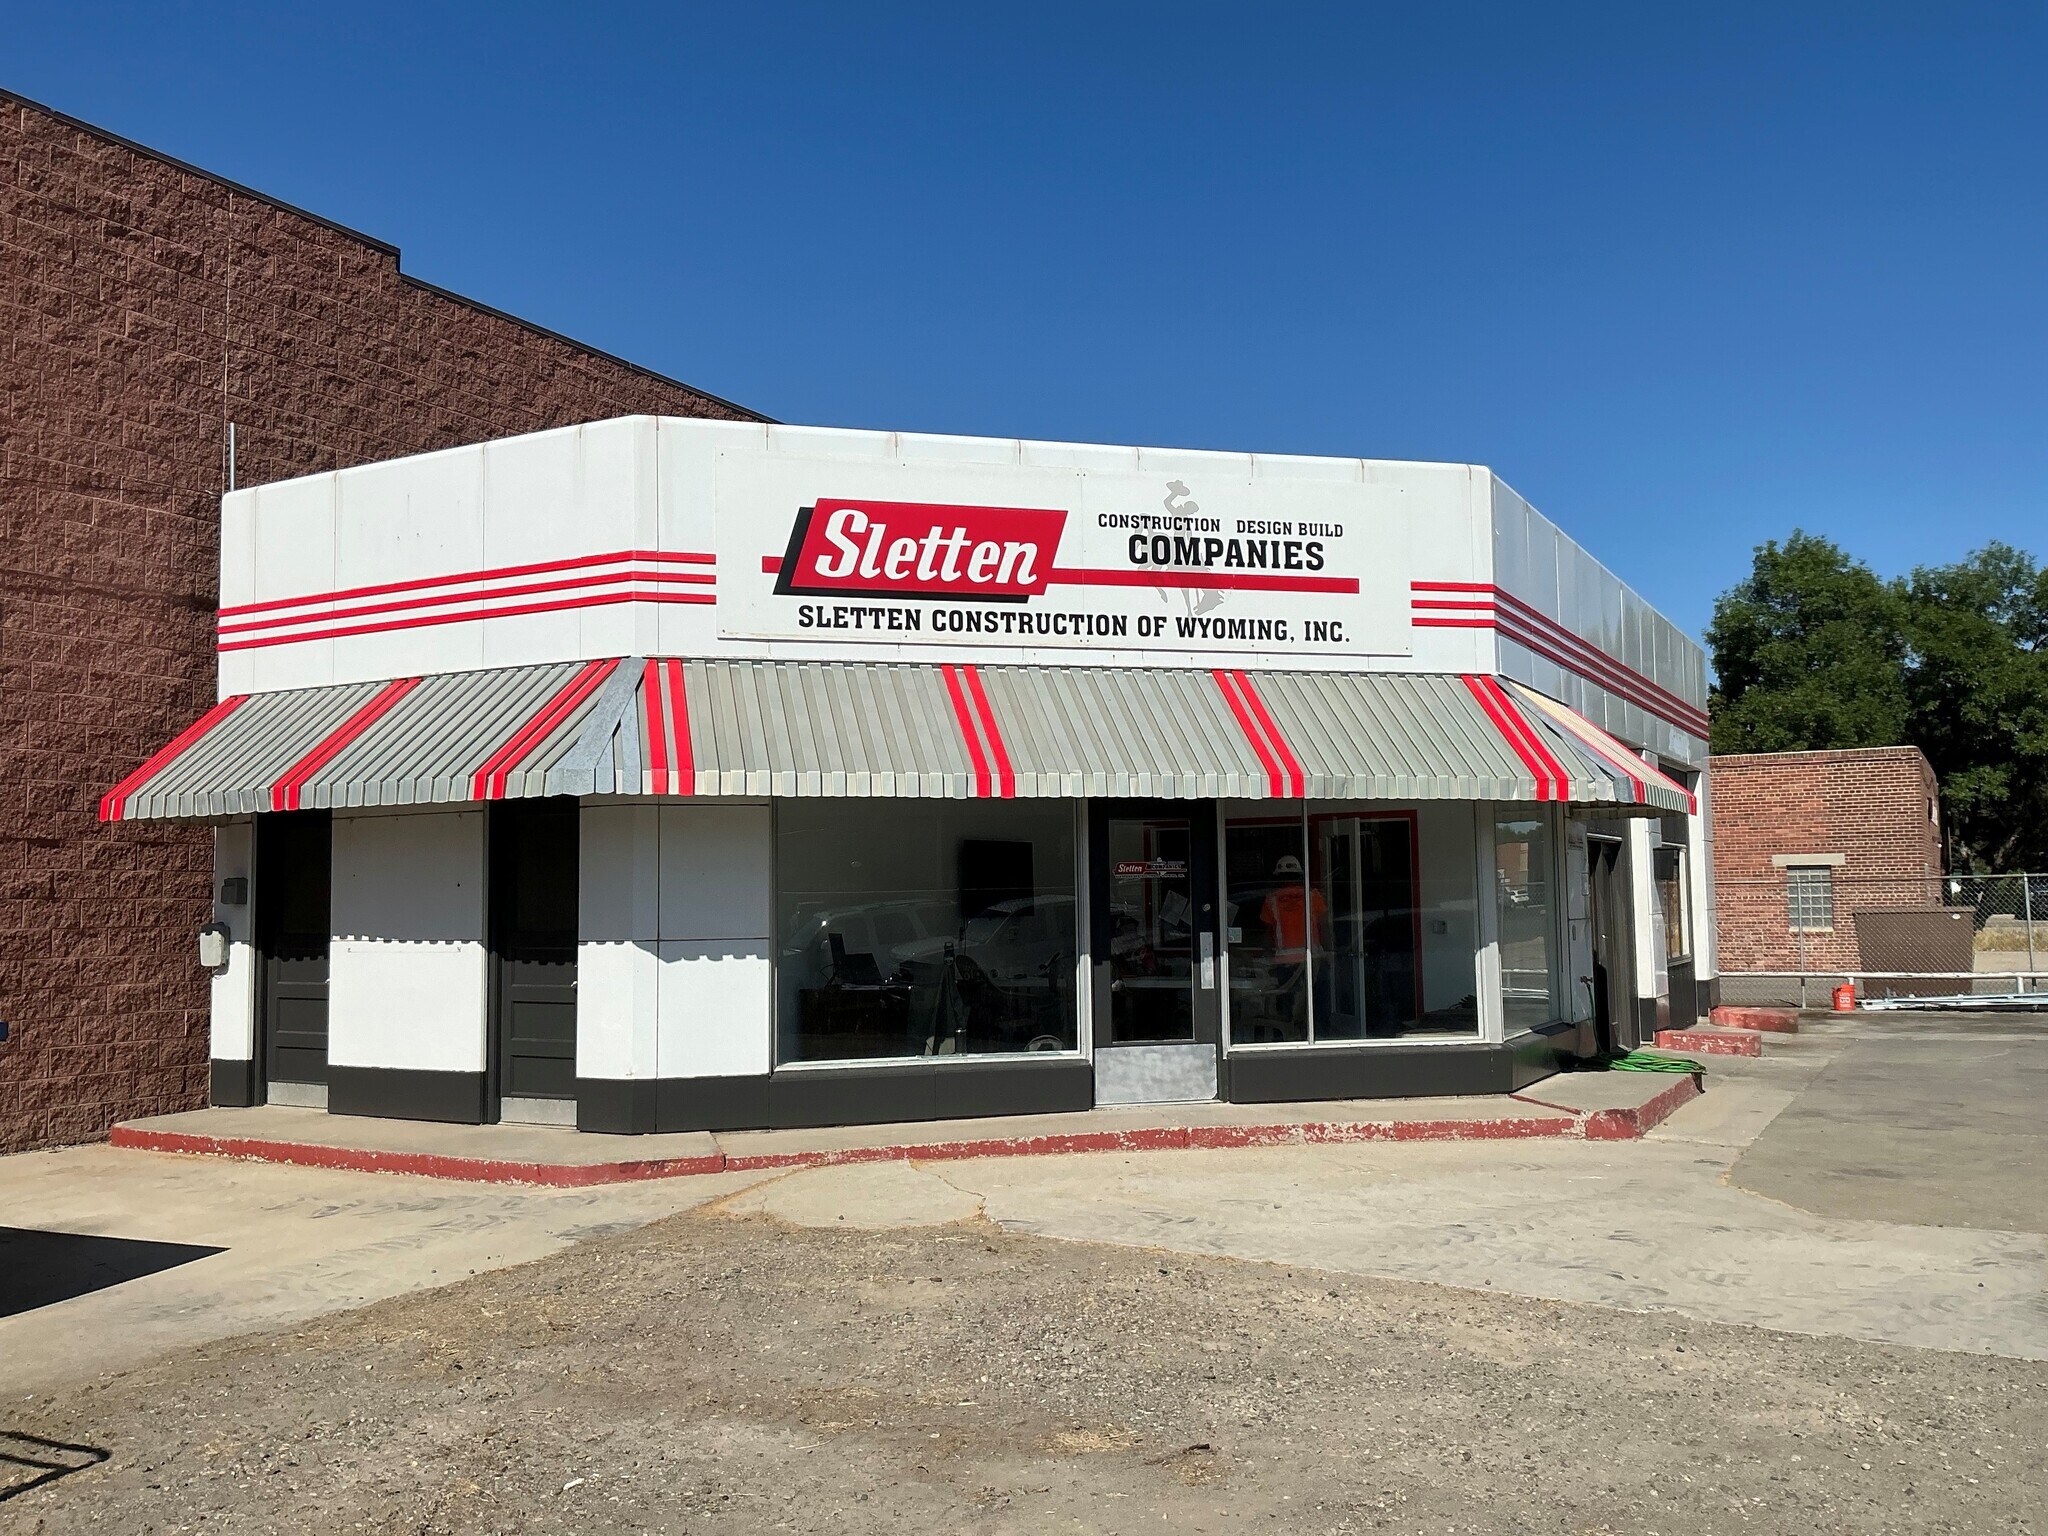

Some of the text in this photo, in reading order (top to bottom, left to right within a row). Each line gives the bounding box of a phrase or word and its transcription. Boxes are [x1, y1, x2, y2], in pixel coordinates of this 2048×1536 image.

[1098, 513, 1344, 538] CONSTRUCTION DESIGN BUILD
[814, 508, 1038, 585] Sletten
[1128, 534, 1325, 571] COMPANIES
[798, 605, 1351, 643] SLETTEN CONSTRUCTION OF WYOMING, INC.
